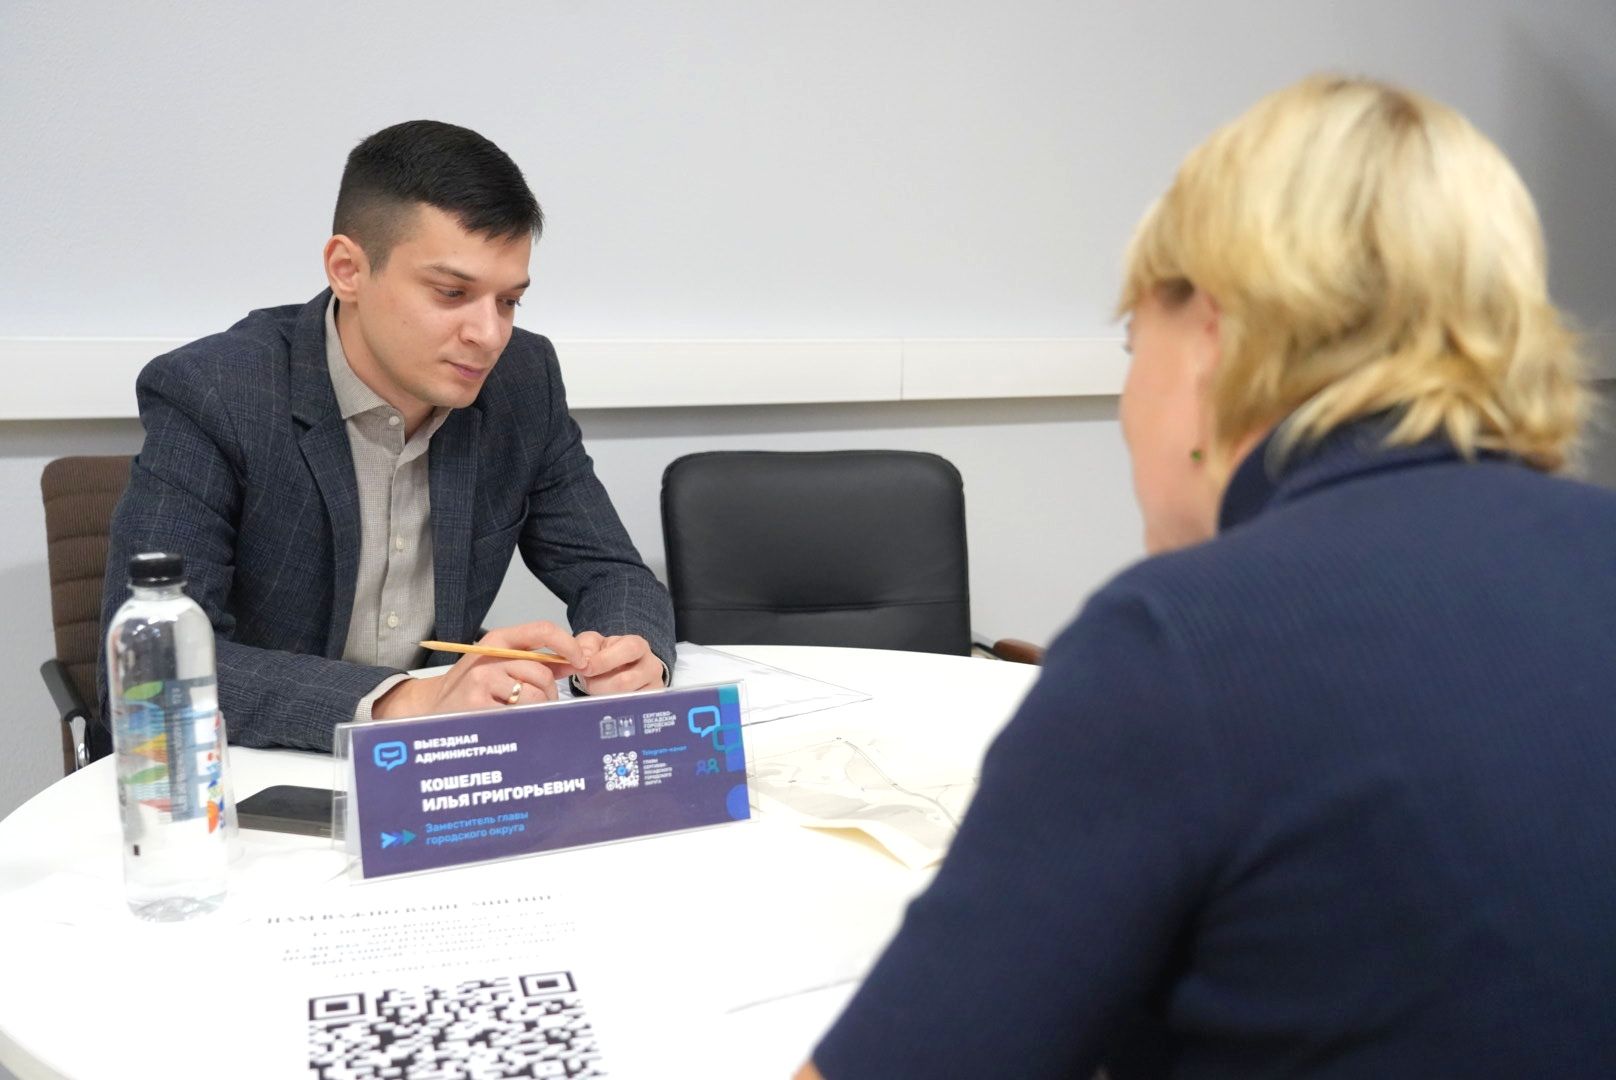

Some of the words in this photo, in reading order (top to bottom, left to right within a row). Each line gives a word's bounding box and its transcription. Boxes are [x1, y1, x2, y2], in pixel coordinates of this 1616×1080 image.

[413, 733, 479, 750] ВЫЕЗДНАЯ
[415, 742, 518, 764] АДМИНИСТРАЦИЯ
[420, 770, 503, 793] КОШЕЛЕВ
[422, 793, 470, 812] ИЛЬЯ
[472, 778, 585, 805] ГРИГОРЬЕВИЧ
[425, 815, 496, 834] Заместитель
[497, 811, 529, 823] главы
[426, 829, 488, 846] городского
[489, 823, 525, 838] округа
